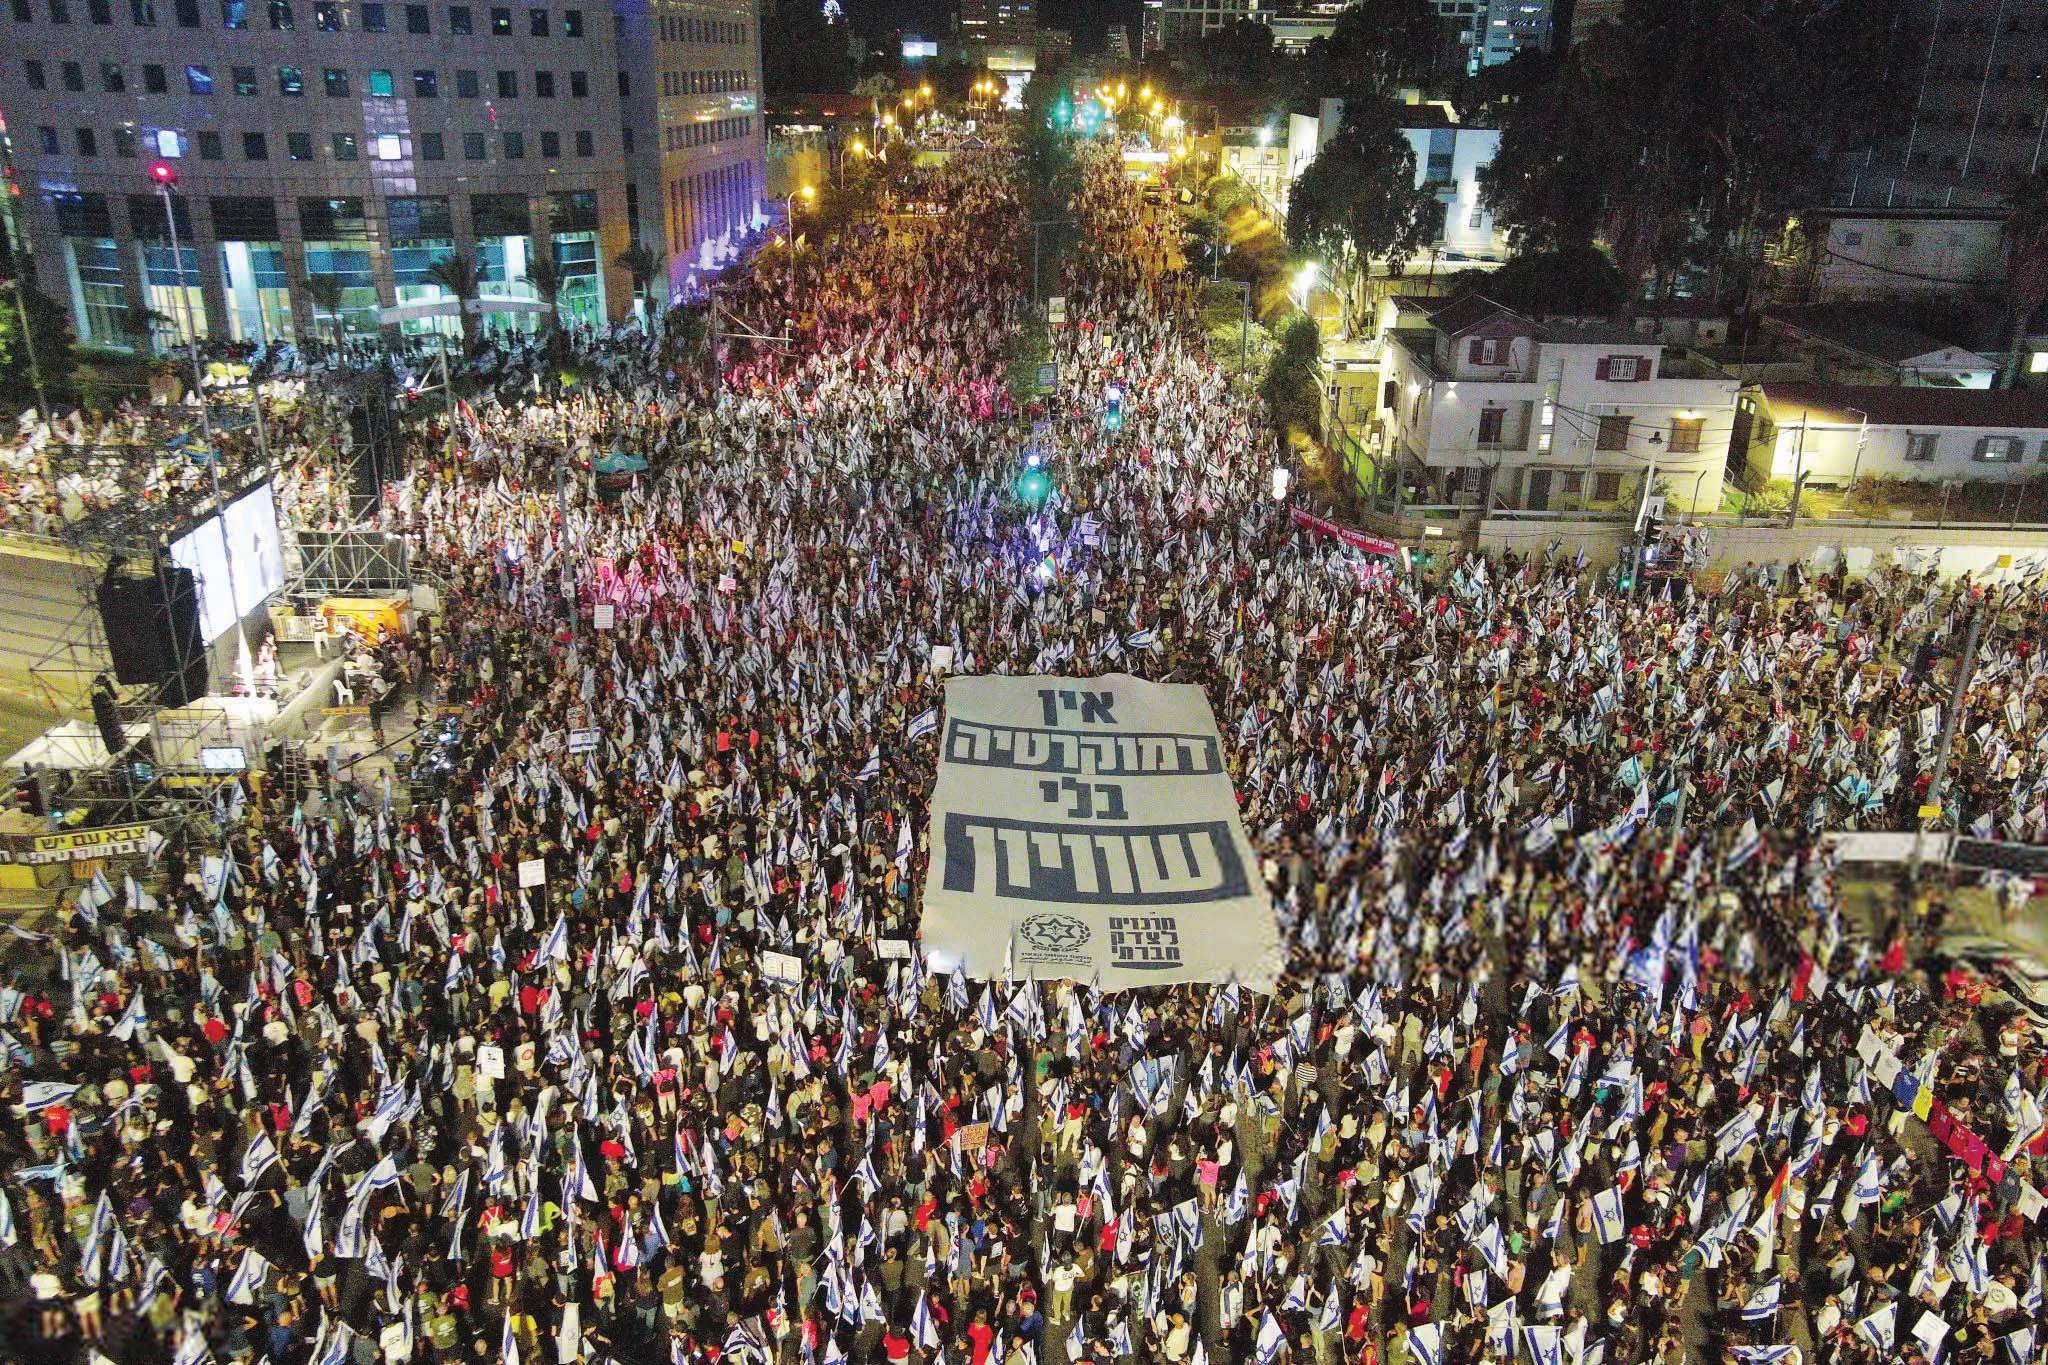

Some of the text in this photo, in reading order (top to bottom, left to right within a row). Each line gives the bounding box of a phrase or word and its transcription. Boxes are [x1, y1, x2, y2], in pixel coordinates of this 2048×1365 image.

[1038, 689, 1118, 726] אין
[953, 722, 1210, 775] דמוקרטיה
[1039, 776, 1129, 820] בלי
[41, 827, 146, 849] צבא עם יש
[965, 824, 1224, 896] שוויון
[1109, 916, 1176, 931] מרכזים
[1110, 930, 1179, 946] לצדק
[1111, 946, 1181, 960] חברתי
